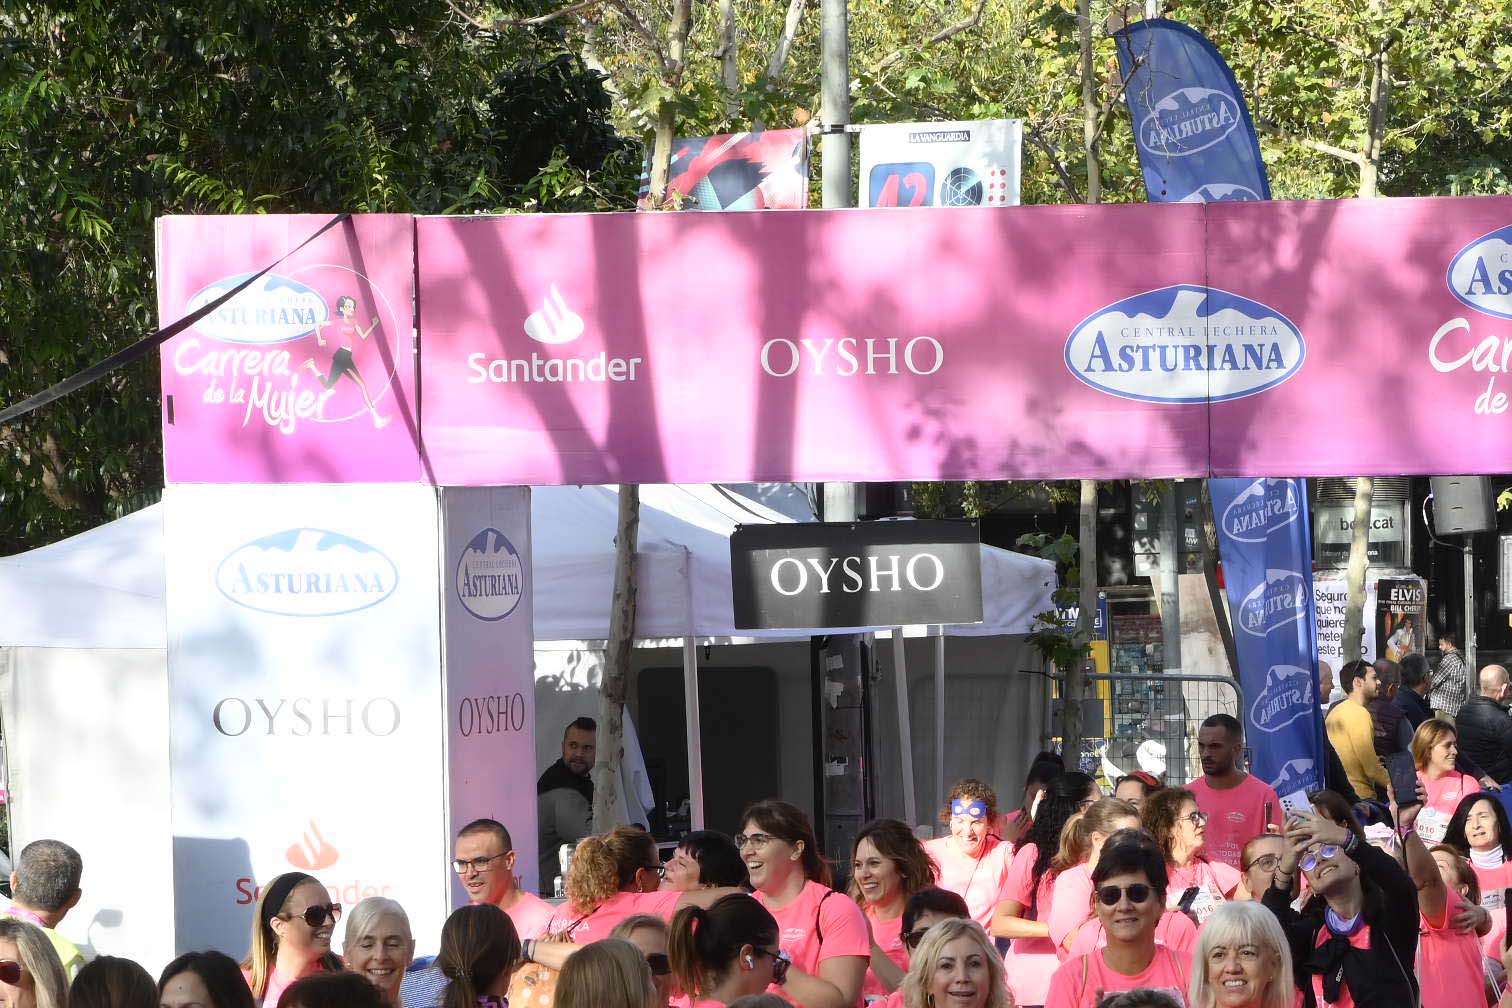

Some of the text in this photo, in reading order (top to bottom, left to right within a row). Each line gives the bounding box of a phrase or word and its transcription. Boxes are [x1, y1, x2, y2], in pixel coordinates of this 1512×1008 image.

[1084, 330, 1285, 374] ASTURIANA
[1121, 327, 1198, 338] CENTRAL
[175, 338, 291, 377] Carrera
[467, 348, 641, 384] Santander
[760, 336, 944, 377] OYSHO
[203, 372, 336, 434] de la Mujer
[1474, 375, 1508, 416] de
[232, 562, 384, 593] ASTURIANA
[462, 564, 519, 599] ASTURIANA
[770, 552, 944, 597] OYSHO
[1316, 607, 1332, 618] que
[1390, 589, 1421, 601] ELVIS
[1318, 645, 1336, 654] este
[212, 697, 400, 737] OYSHO
[459, 693, 524, 737] OYSHO
